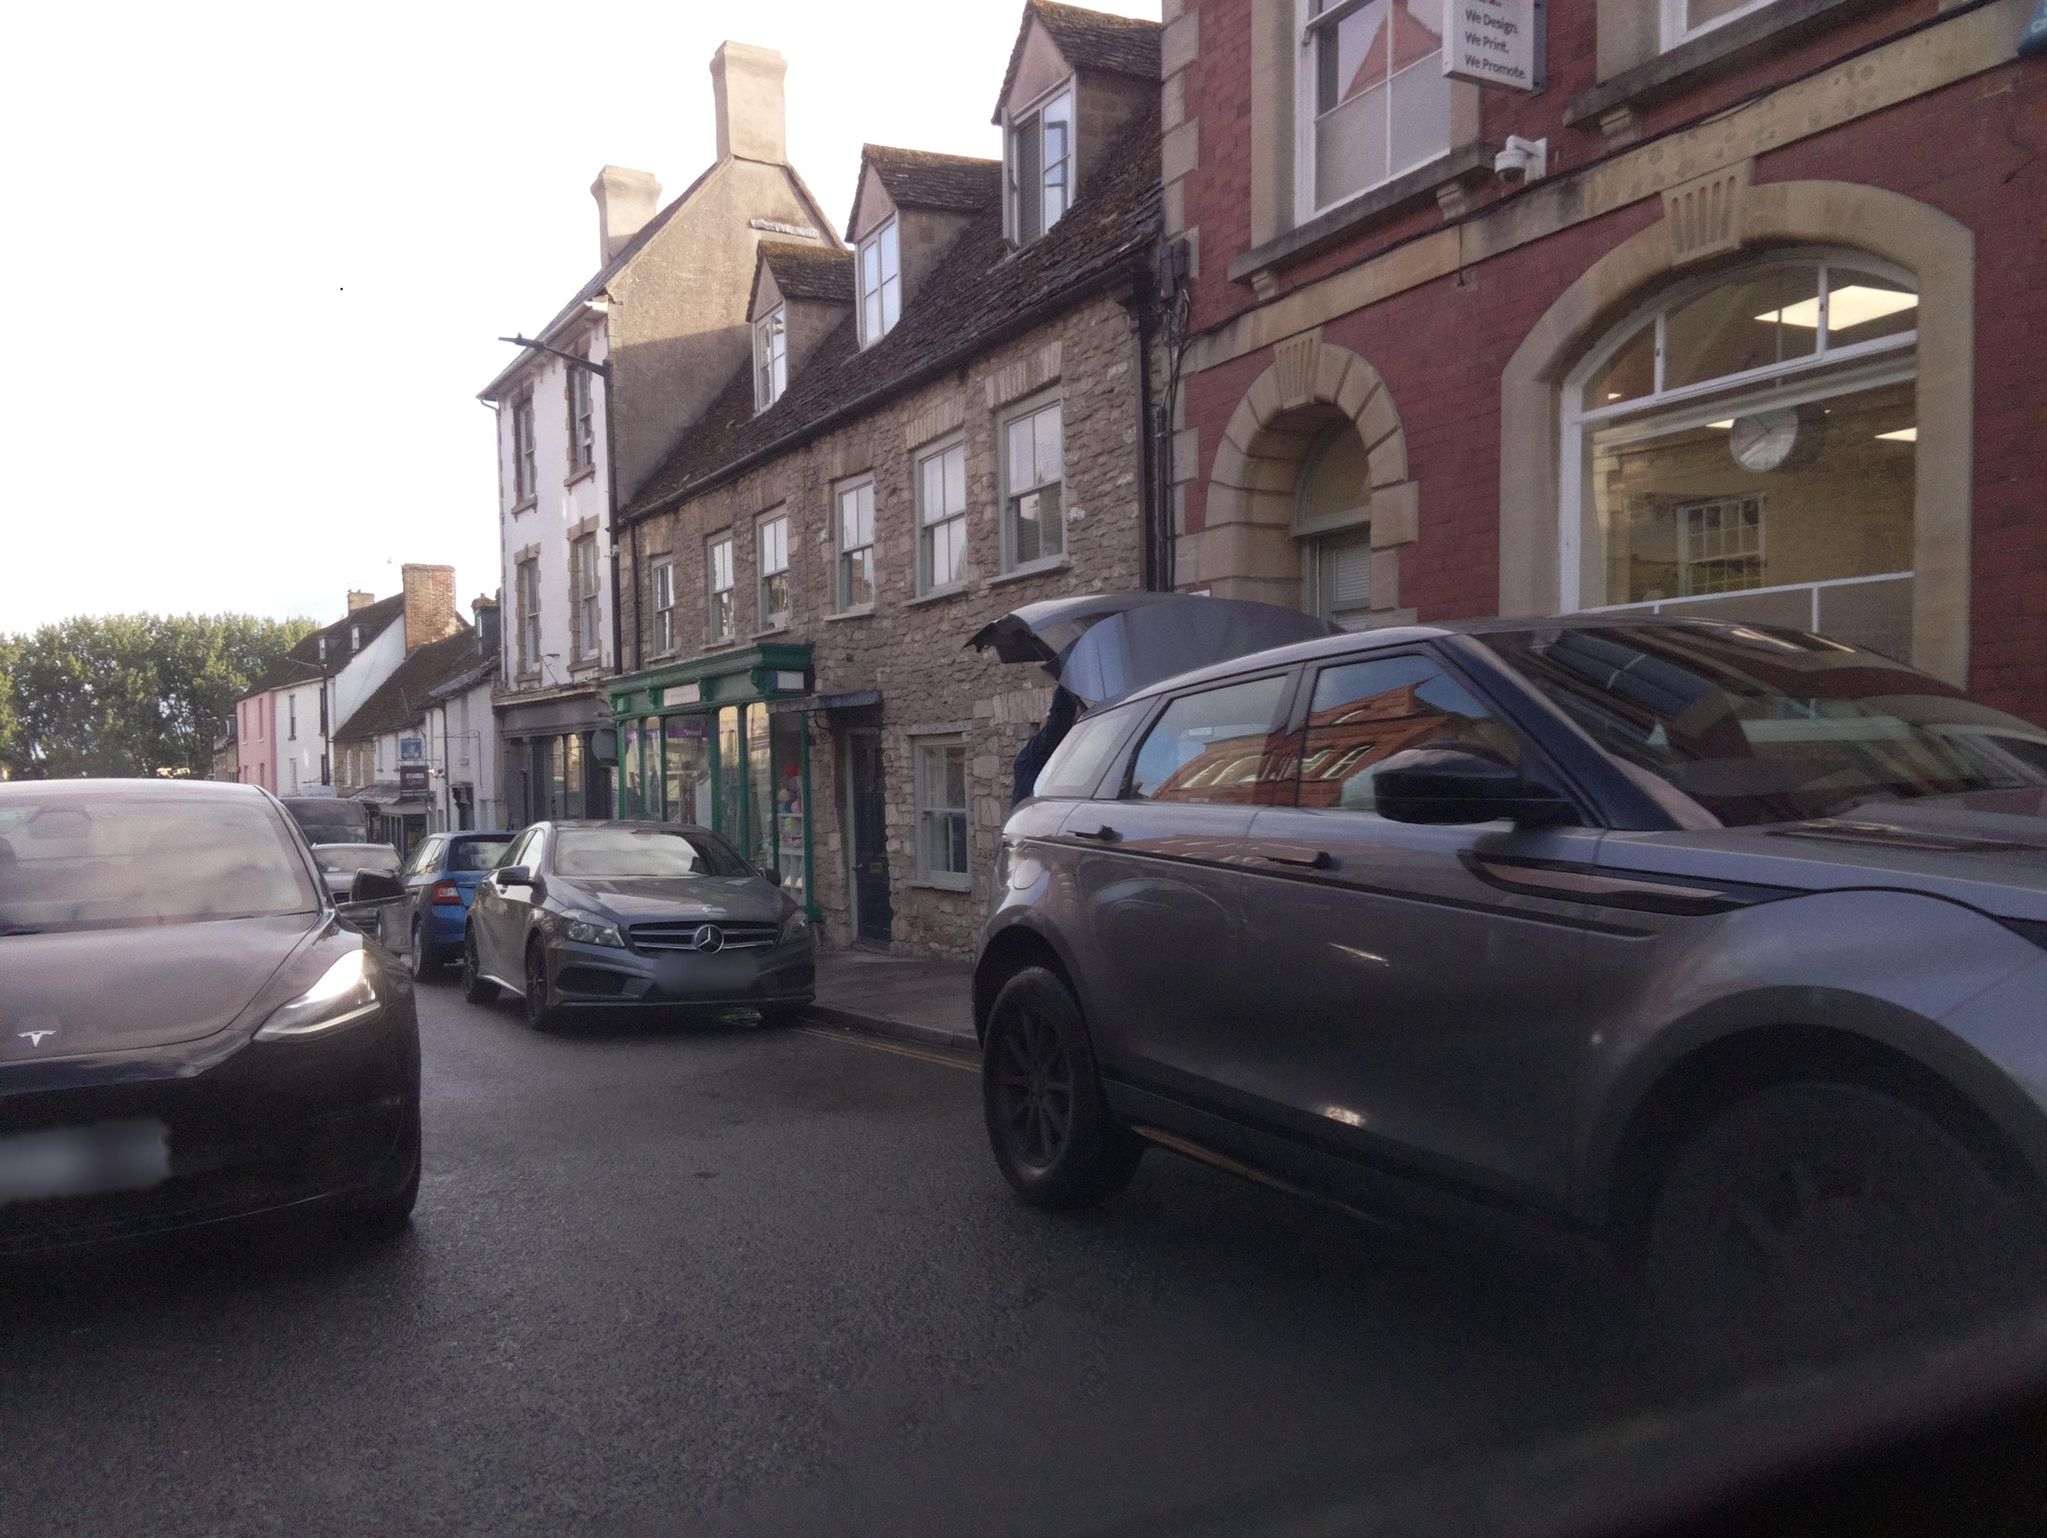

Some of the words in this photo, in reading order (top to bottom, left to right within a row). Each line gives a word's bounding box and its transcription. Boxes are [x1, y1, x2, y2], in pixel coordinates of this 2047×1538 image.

[1465, 8, 1481, 24] We
[1465, 31, 1481, 46] We
[1464, 53, 1481, 69] We
